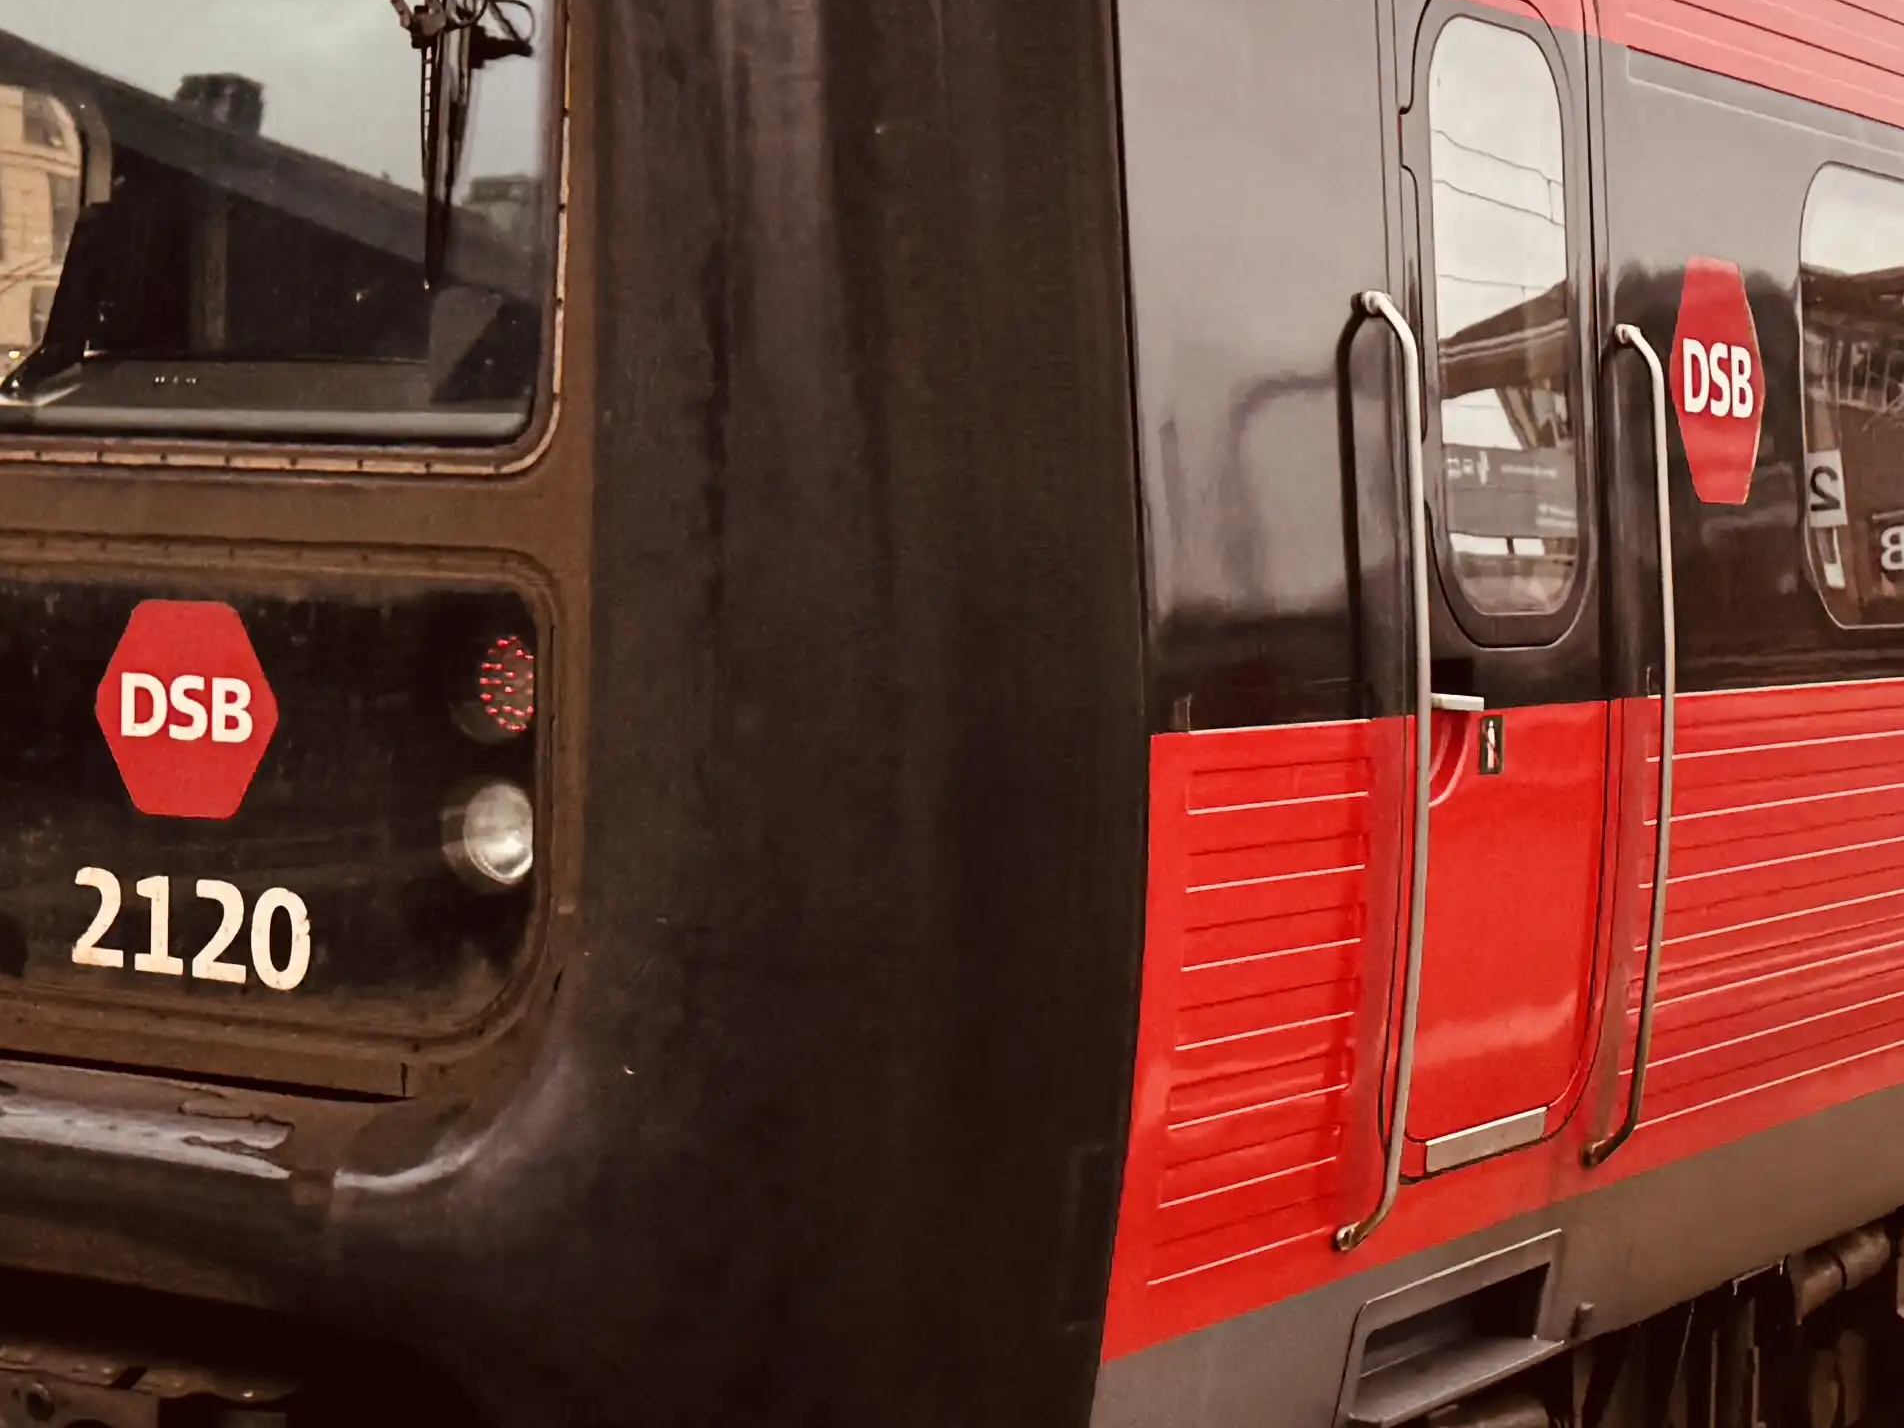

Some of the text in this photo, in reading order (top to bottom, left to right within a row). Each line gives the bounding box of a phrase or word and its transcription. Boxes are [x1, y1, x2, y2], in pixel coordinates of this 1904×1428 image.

[1681, 336, 1755, 420] DSB
[119, 670, 254, 744] DSB
[70, 865, 312, 992] 2120
